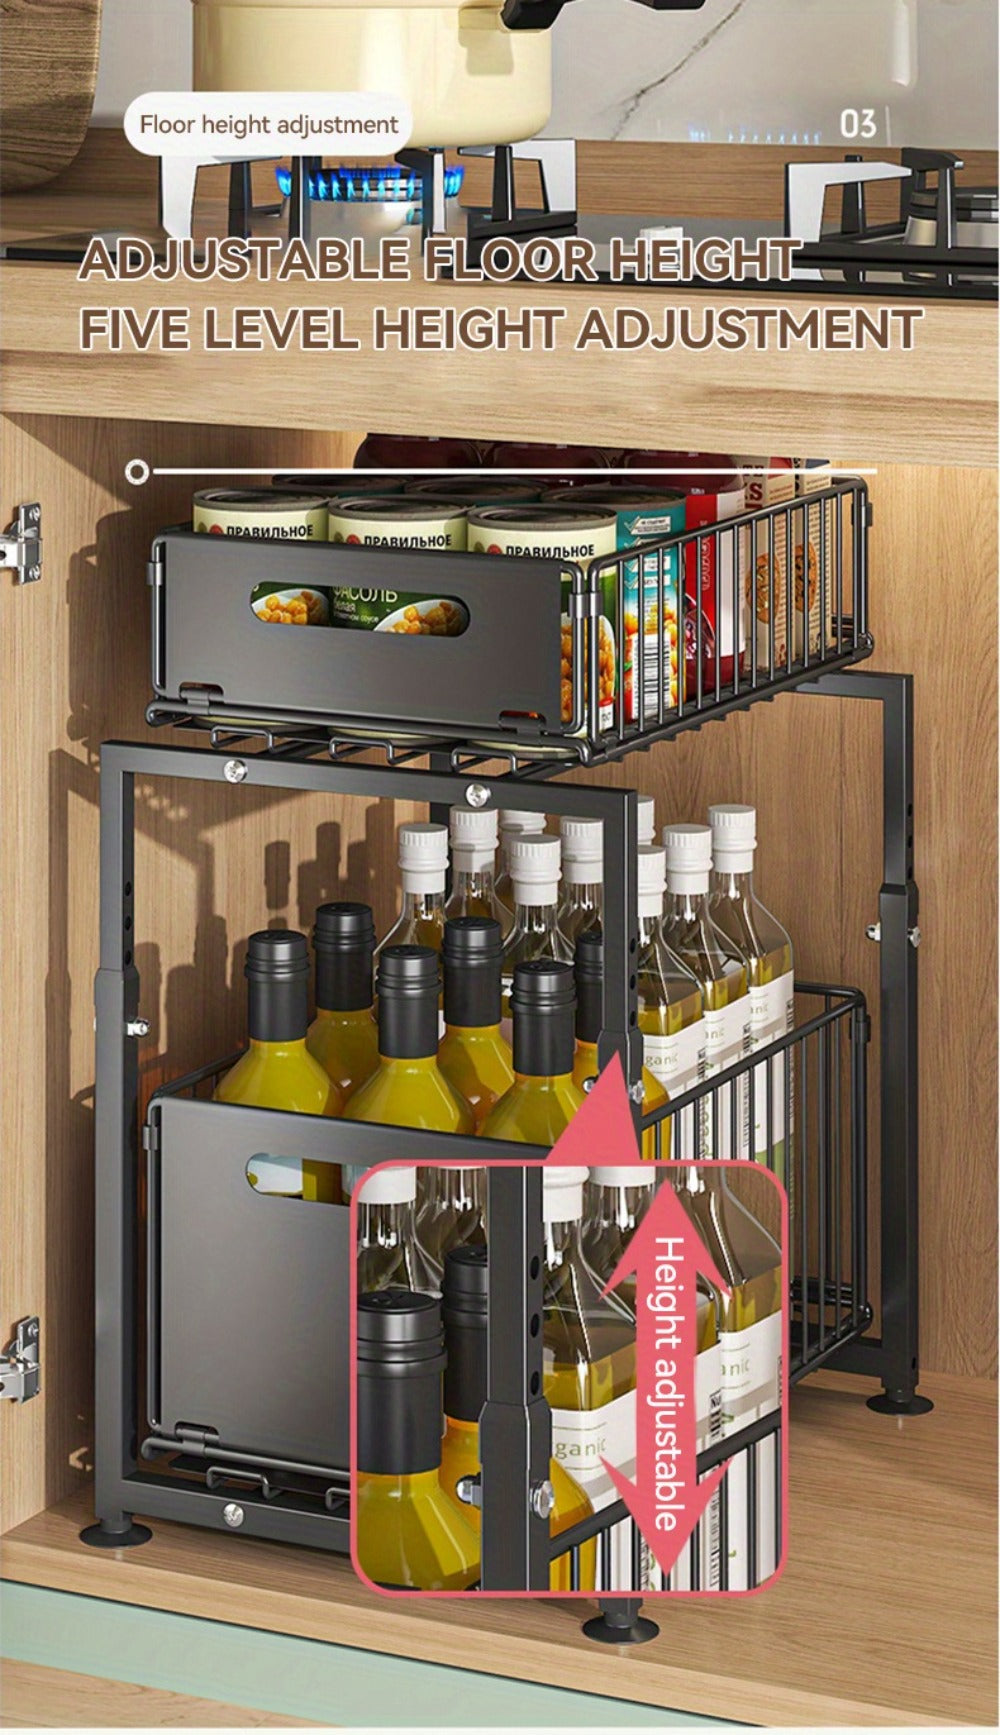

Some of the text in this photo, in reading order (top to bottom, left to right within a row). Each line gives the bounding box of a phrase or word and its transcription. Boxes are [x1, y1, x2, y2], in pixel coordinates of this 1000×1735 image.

[226, 525, 314, 538] ПРАВИЛЬНОЕ
[363, 534, 452, 548] ПРАВИЛЬНОЕ
[505, 544, 595, 559] ПРАВИЛЬНОЕ
[645, 1052, 679, 1068] ganic
[555, 1437, 607, 1460] ganic
